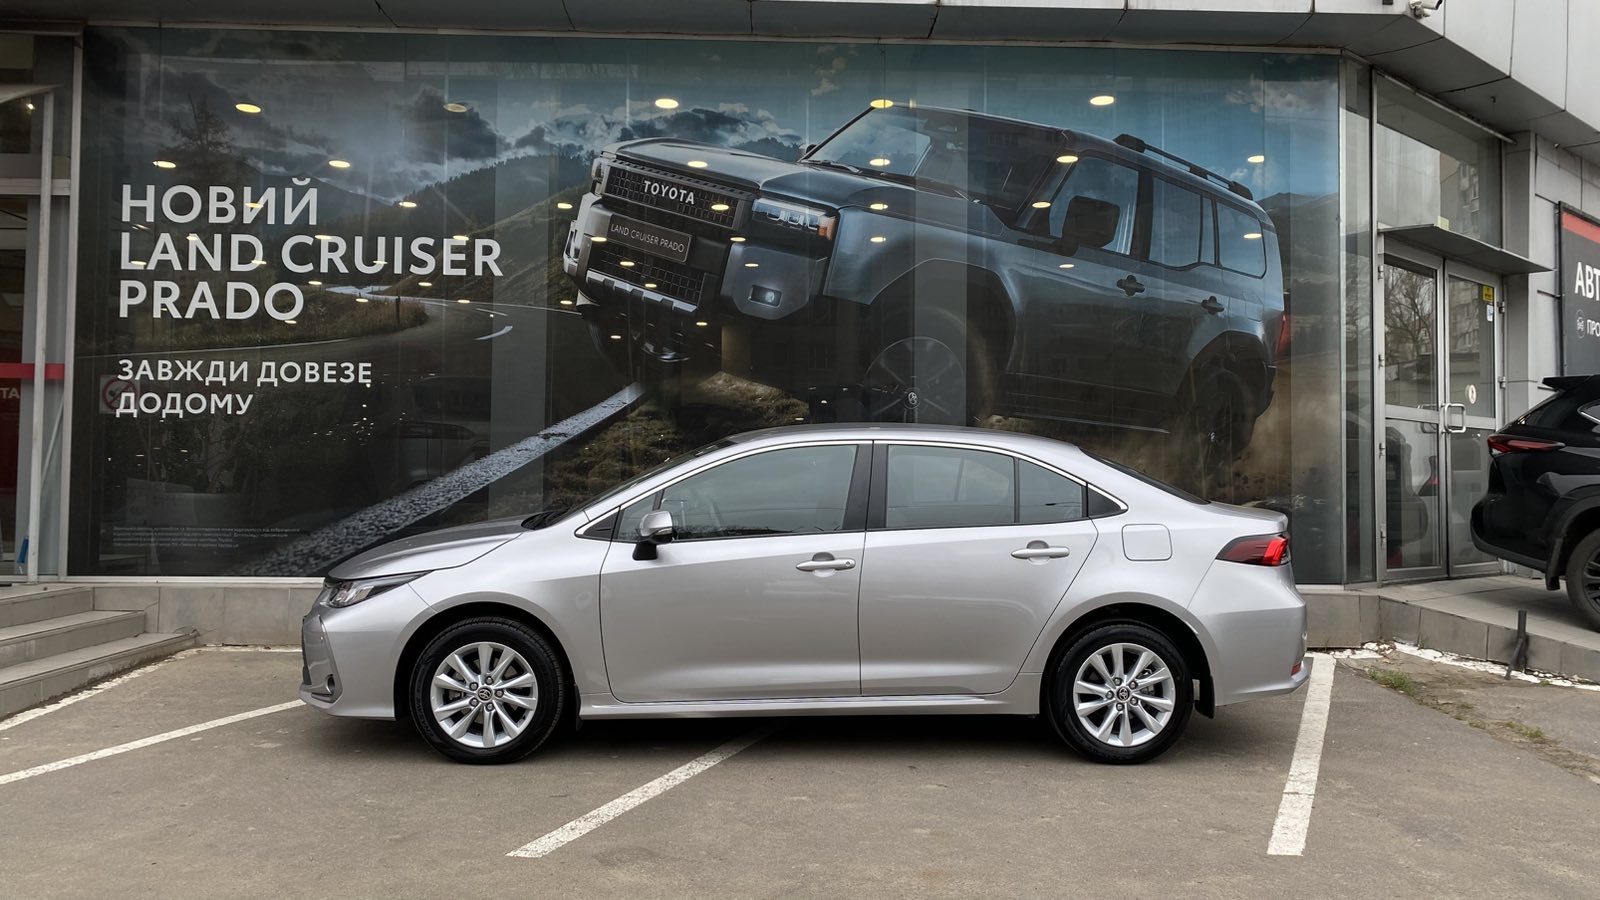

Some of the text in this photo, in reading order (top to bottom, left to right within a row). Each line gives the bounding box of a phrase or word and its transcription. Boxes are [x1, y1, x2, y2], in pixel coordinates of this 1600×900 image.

[121, 177, 318, 226] НОВИЙ
[643, 180, 695, 205] TOYOTA
[610, 223, 685, 253] LAND CRUISER PRADO
[120, 232, 504, 277] LAND CRUISER
[119, 280, 304, 323] PRADO
[117, 359, 372, 387] ЗАВЖДИ ДОВЕЗЕ
[115, 392, 254, 419] ДОДОМУ
